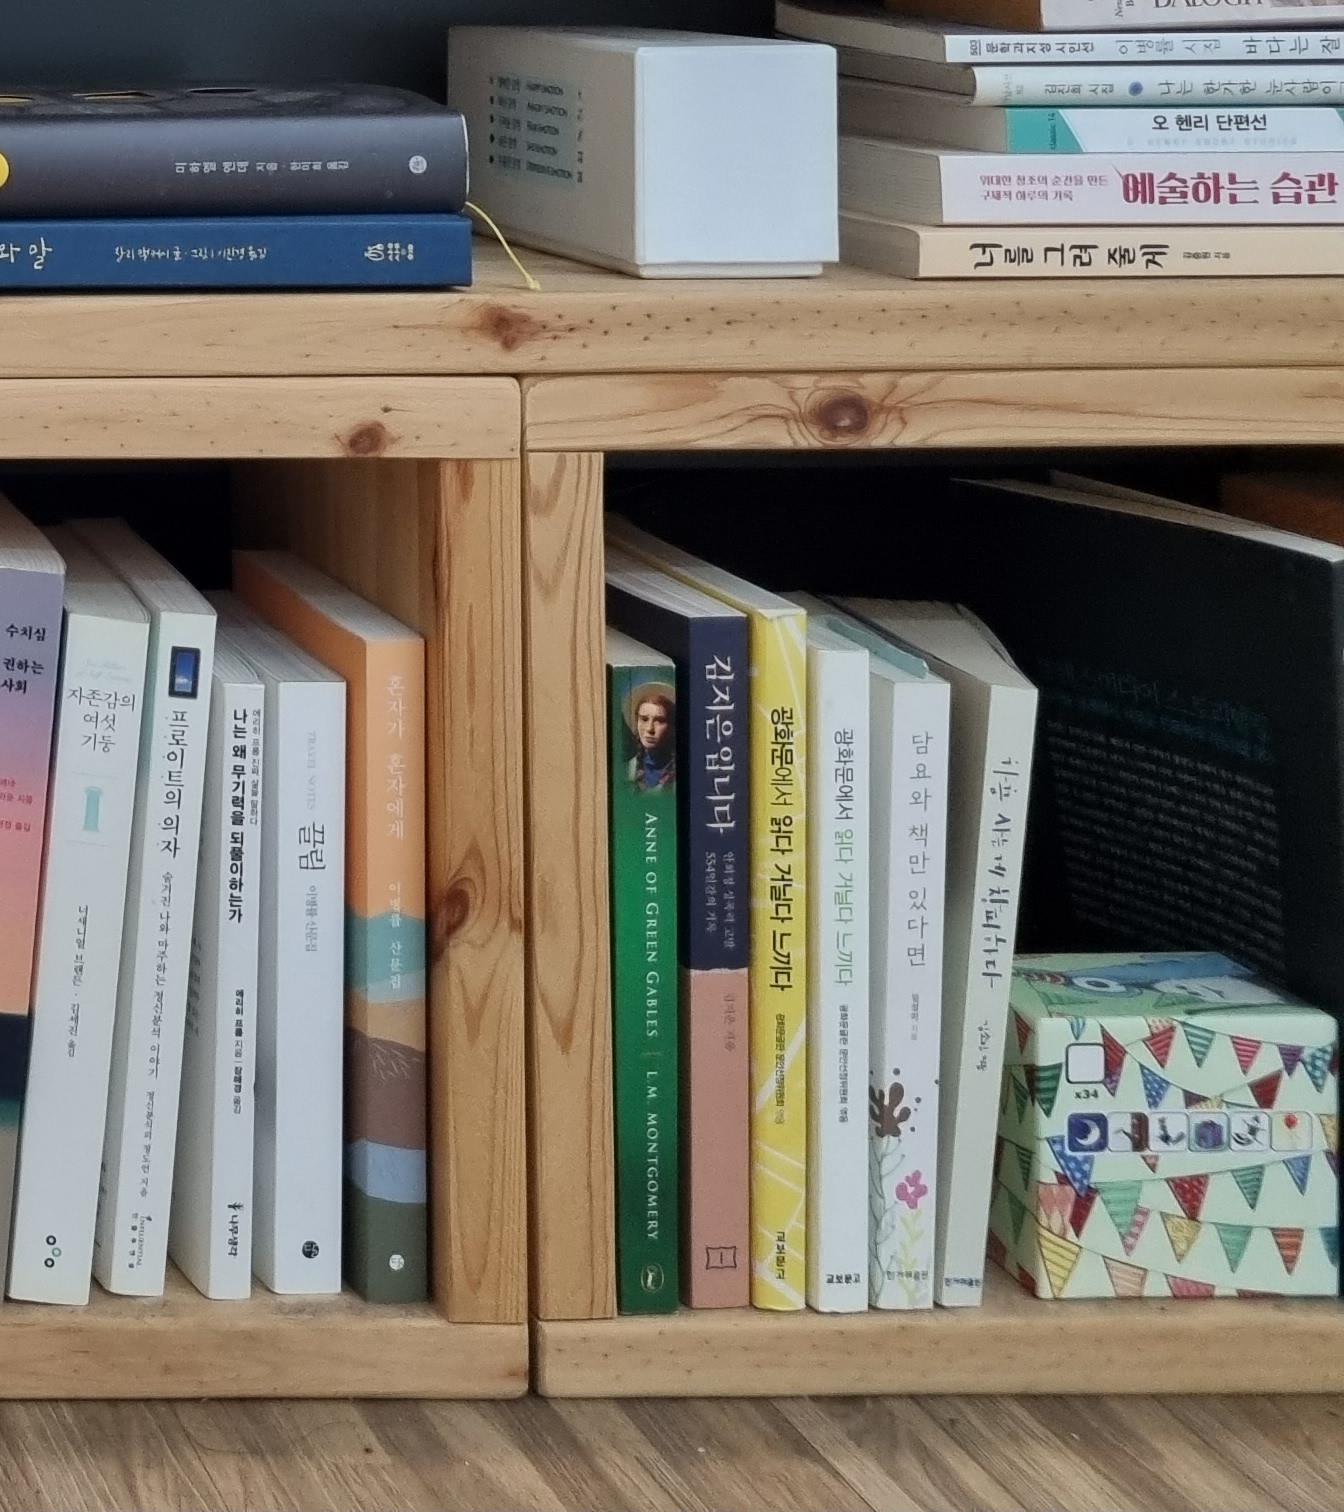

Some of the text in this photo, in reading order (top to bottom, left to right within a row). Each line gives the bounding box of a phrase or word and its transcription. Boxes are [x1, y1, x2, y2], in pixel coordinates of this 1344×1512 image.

[986, 42, 1051, 54] 문학과지성
[1152, 114, 1268, 131] 오 헨리 단편선
[979, 175, 1012, 187] 위대한
[1122, 171, 1340, 206] 예술하는 습관
[28, 237, 53, 270] 말
[969, 242, 1035, 270] 너를
[1044, 242, 1099, 268] 그려
[1107, 242, 1170, 270] 줄게
[5, 623, 47, 642] 수치심
[3, 657, 45, 674] 권하는
[0, 678, 28, 694] 사회
[66, 686, 136, 713] 자존감의
[82, 712, 117, 733] 여섯
[80, 733, 116, 753] 기둥
[704, 654, 737, 835] 김지은입니다
[230, 708, 248, 826] 나는 왜 무기력을
[907, 730, 934, 812] 담요와
[160, 710, 191, 859] 프로이트의 의자
[298, 820, 326, 871] 끌림
[769, 706, 794, 991] 광화문에서 읽다 거닐다 느끼다
[834, 727, 855, 987] 광화문에서 읽다 거닐다 느끼다
[907, 822, 931, 876] 책만
[906, 887, 930, 968] 있다면
[234, 988, 244, 1016] 에리히
[644, 812, 660, 1241] ANNE OF GREEN GABLES MONTGOMERY
[825, 1273, 861, 1284] 교보문고
